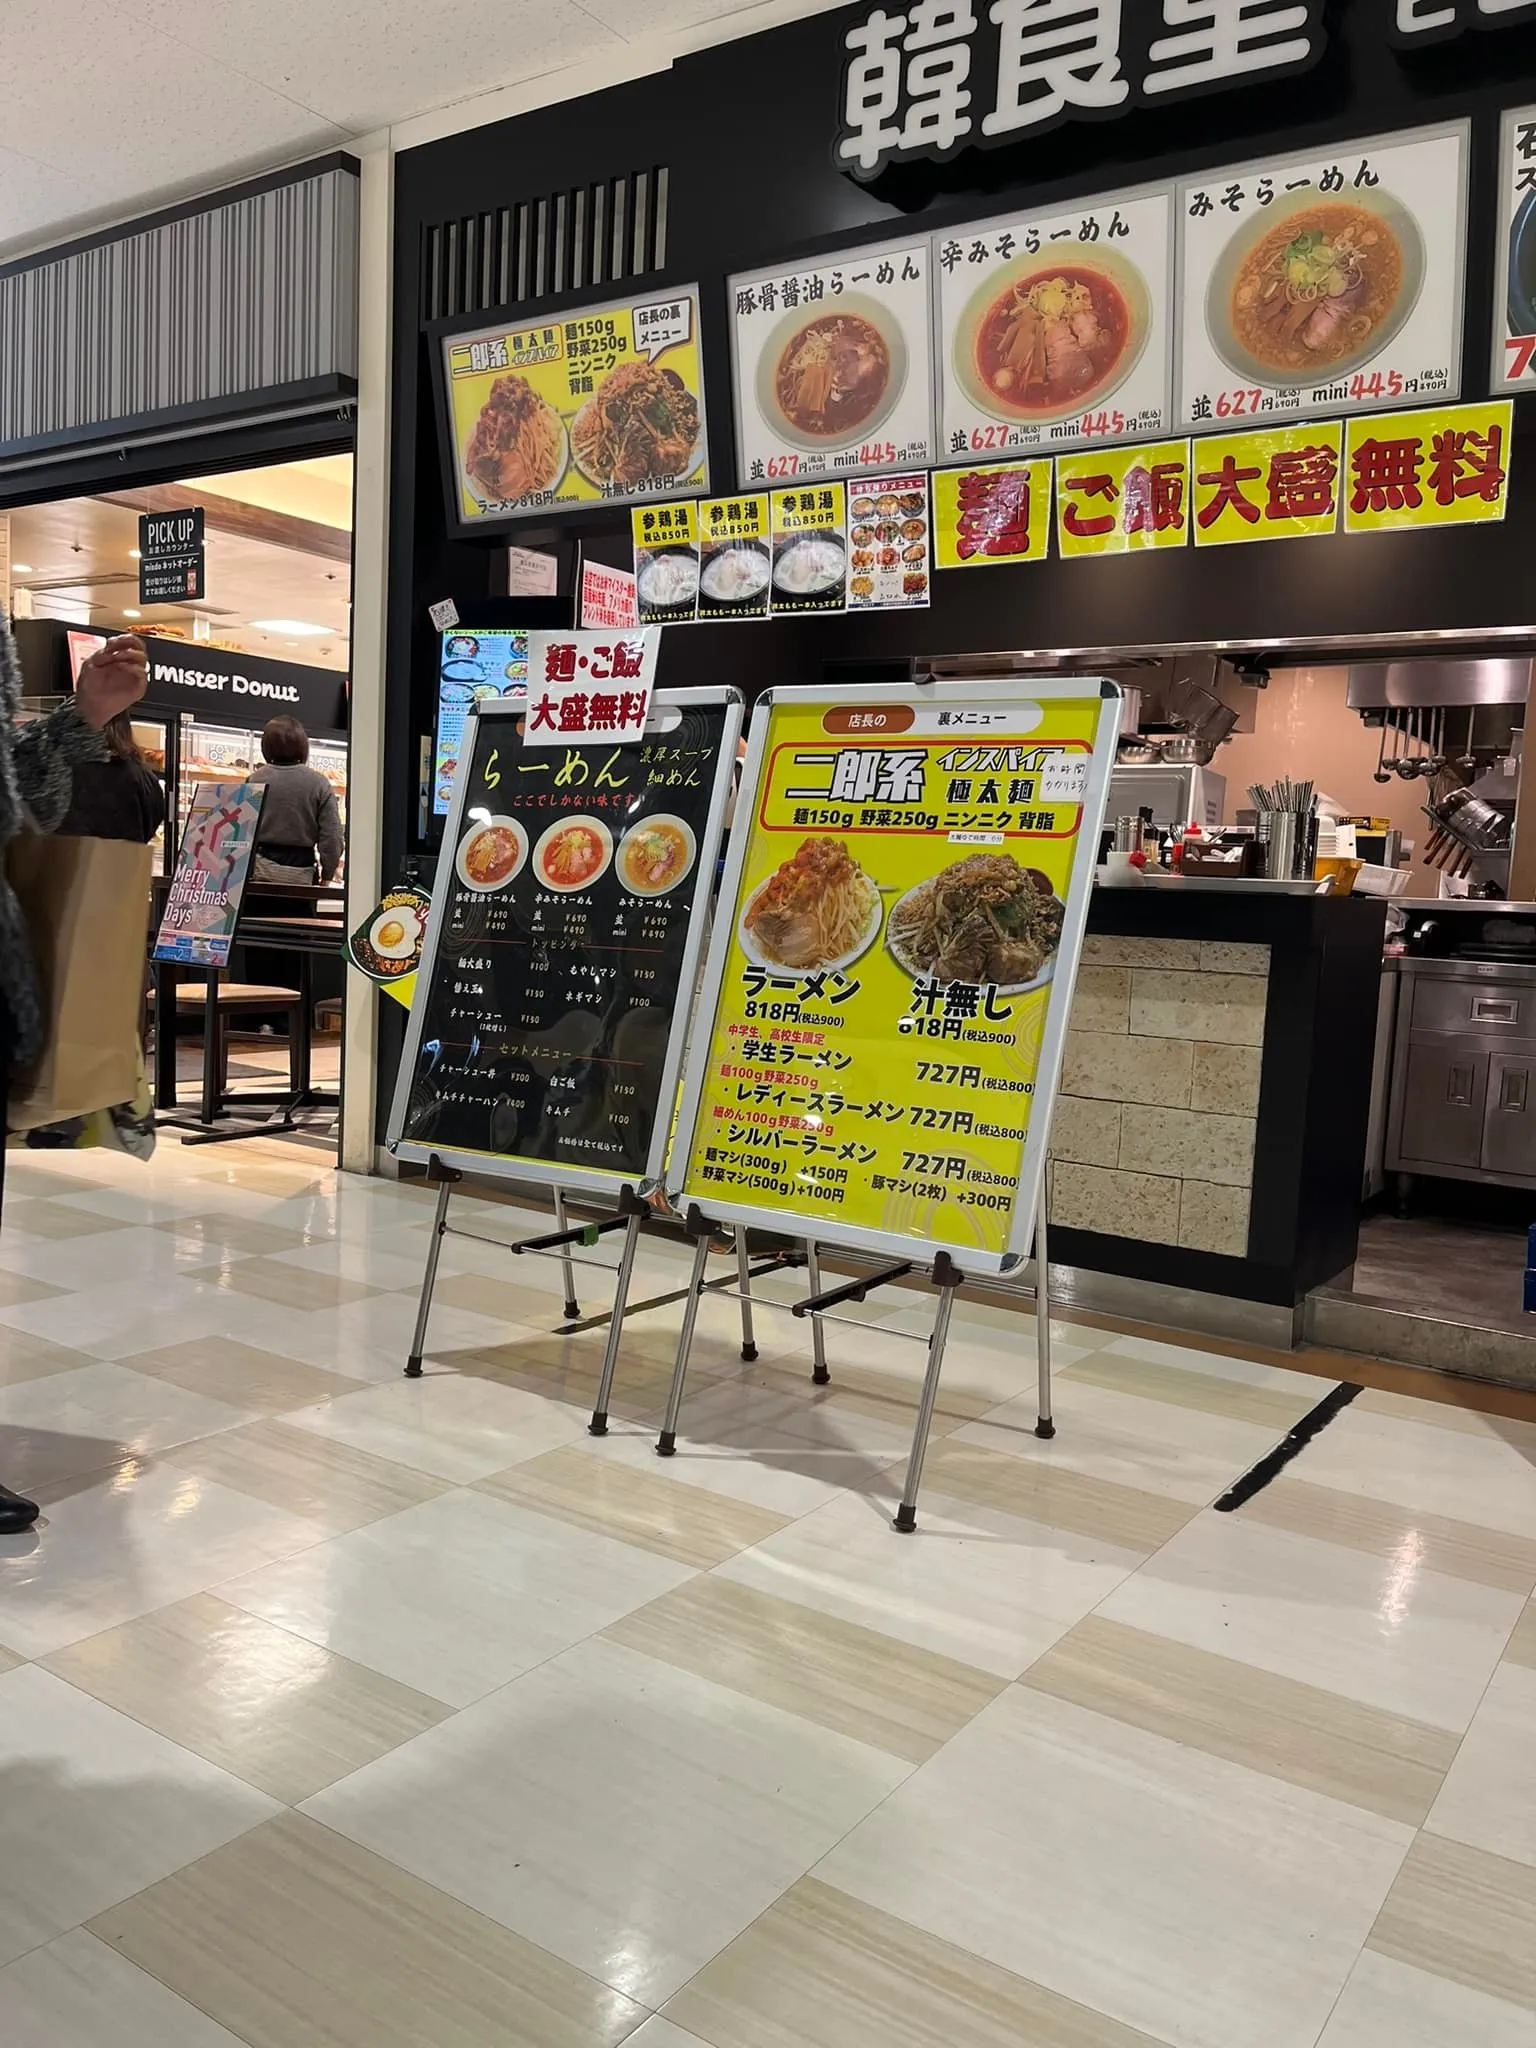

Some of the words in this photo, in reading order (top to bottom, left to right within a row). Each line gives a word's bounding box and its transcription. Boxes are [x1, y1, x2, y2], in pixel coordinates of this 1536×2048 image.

[1188, 160, 1380, 219] みそらーめん
[941, 210, 1131, 273] 辛みそらーめん
[736, 256, 921, 316] 豚骨醤油らーめん
[638, 304, 681, 325] 店長の裏
[565, 319, 615, 341] 麺150g
[640, 329, 682, 344] メニュー
[452, 339, 510, 373] 二郎系
[566, 336, 627, 359] 野菜250g
[568, 353, 616, 377] ニンニク
[568, 378, 593, 395] 背脂
[1061, 461, 1187, 539] ご飯
[1197, 444, 1338, 531] 大盛
[1351, 424, 1506, 513] 無料
[709, 503, 759, 524] 参鶏湯
[782, 491, 833, 514] 参鶏湯
[642, 511, 689, 531] 参鶏湯
[710, 521, 760, 537] 税込850円
[782, 512, 835, 527] 税込850円
[147, 520, 175, 545] PICK
[178, 518, 195, 541] UP
[643, 528, 690, 543] 税込850円
[232, 675, 300, 702] Donut
[528, 688, 648, 732] 大盛無料
[848, 713, 887, 728] 店長の
[937, 711, 1008, 727] 裏メニュー
[640, 746, 714, 763] 濃厚スープ
[484, 747, 630, 790] らーめん
[646, 768, 701, 787] 細めん
[784, 748, 929, 803] 二郎系
[946, 778, 1036, 804] 極太麺
[793, 807, 854, 830] 麺150g
[860, 809, 938, 830] 野菜250g
[944, 812, 1012, 829] ニンニク
[1018, 812, 1055, 831] 背脂
[173, 862, 212, 889] Merry
[168, 882, 229, 907] Christmas
[619, 898, 673, 909] みそらーめん
[163, 902, 194, 929] Days
[741, 965, 862, 1005] ラーメン
[910, 978, 1014, 1021] 汁無し
[450, 1007, 503, 1020] チャーシュー
[727, 1024, 826, 1047] 中学生、高校生限定
[499, 1043, 573, 1060] セットメニュー
[545, 1105, 572, 1118] キムチ
[735, 1083, 905, 1123] レディースラーメン
[727, 1124, 878, 1164] シルバーラーメン
[800, 1165, 848, 1184] +150円
[956, 1191, 1012, 1212] +300円
